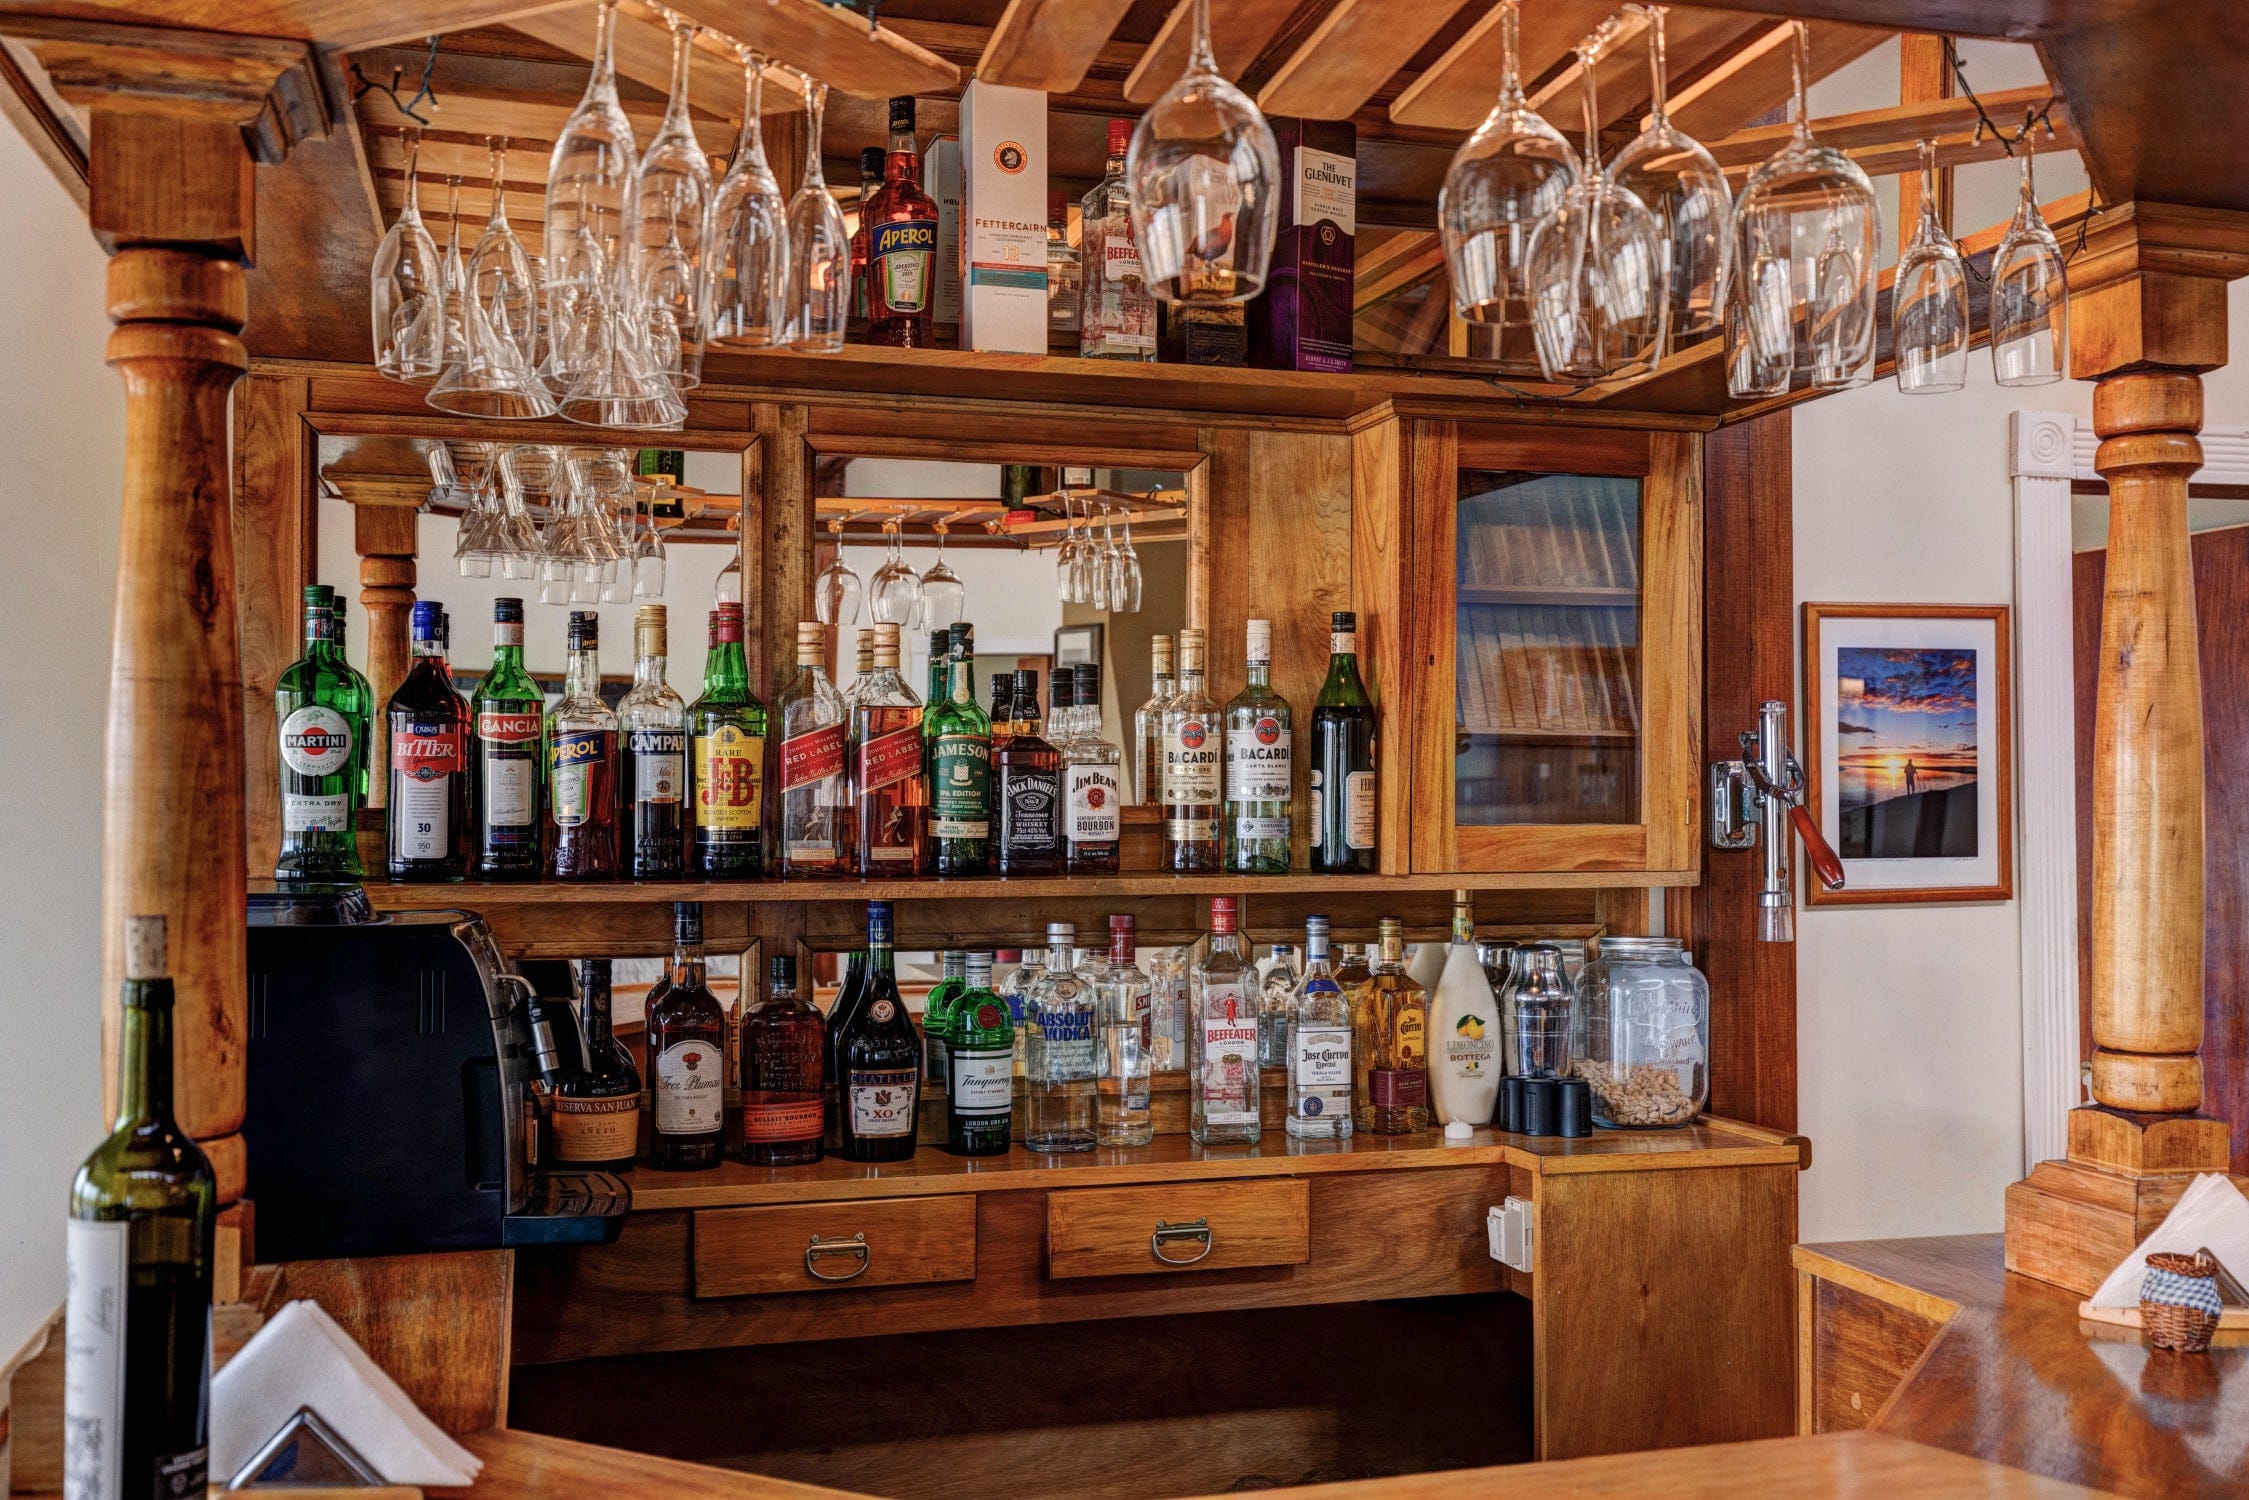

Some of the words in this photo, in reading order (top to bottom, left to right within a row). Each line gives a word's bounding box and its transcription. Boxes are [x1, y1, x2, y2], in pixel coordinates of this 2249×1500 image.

[1322, 162, 1337, 173] THE
[1304, 167, 1353, 189] GLENLIVET
[975, 218, 1047, 233] FETTERCAIRN
[879, 228, 934, 252] APEROL
[1003, 245, 1020, 261] 12
[1106, 246, 1140, 261] BEEFEA
[481, 719, 540, 733] GANCIA
[287, 735, 345, 748] MARTINI
[396, 739, 457, 758] BITTER
[629, 735, 685, 752] CAMPAR
[788, 741, 814, 754] JOHNNIE
[868, 742, 893, 756] JOHNNIE
[548, 740, 598, 764] APEROL
[785, 752, 807, 766] RED
[809, 741, 842, 758] LABEL
[864, 754, 886, 767] RED
[888, 742, 920, 759] LABEL
[932, 743, 989, 760] JAMESON
[1168, 748, 1218, 764] BACARDÍ
[1240, 744, 1290, 760] BACARDÍ
[1007, 780, 1027, 797] JACK
[1027, 777, 1056, 797] DANIEL'S
[1073, 775, 1091, 793] JIM
[1092, 772, 1117, 792] BEAM
[417, 822, 431, 833] 30
[1077, 820, 1115, 831] BOURBON
[1037, 1010, 1094, 1028] ABSOLUT
[1043, 1026, 1091, 1041] VODKA
[1400, 1020, 1422, 1035] Cuervo
[1207, 1028, 1257, 1044] BEEFEATER
[1302, 1048, 1321, 1062] Jose
[1321, 1048, 1349, 1062] Cuervo
[1450, 1053, 1491, 1062] BOTTEGA
[659, 1075, 681, 1091] Tres
[962, 1074, 1011, 1089] Tanqueray
[556, 1101, 593, 1113] RESERVA
[594, 1102, 614, 1112] SAN
[615, 1099, 636, 1114] JUAN
[872, 1109, 894, 1119] XO
[784, 1113, 817, 1121] BOURBON
[580, 1126, 617, 1135] AÑEJO
